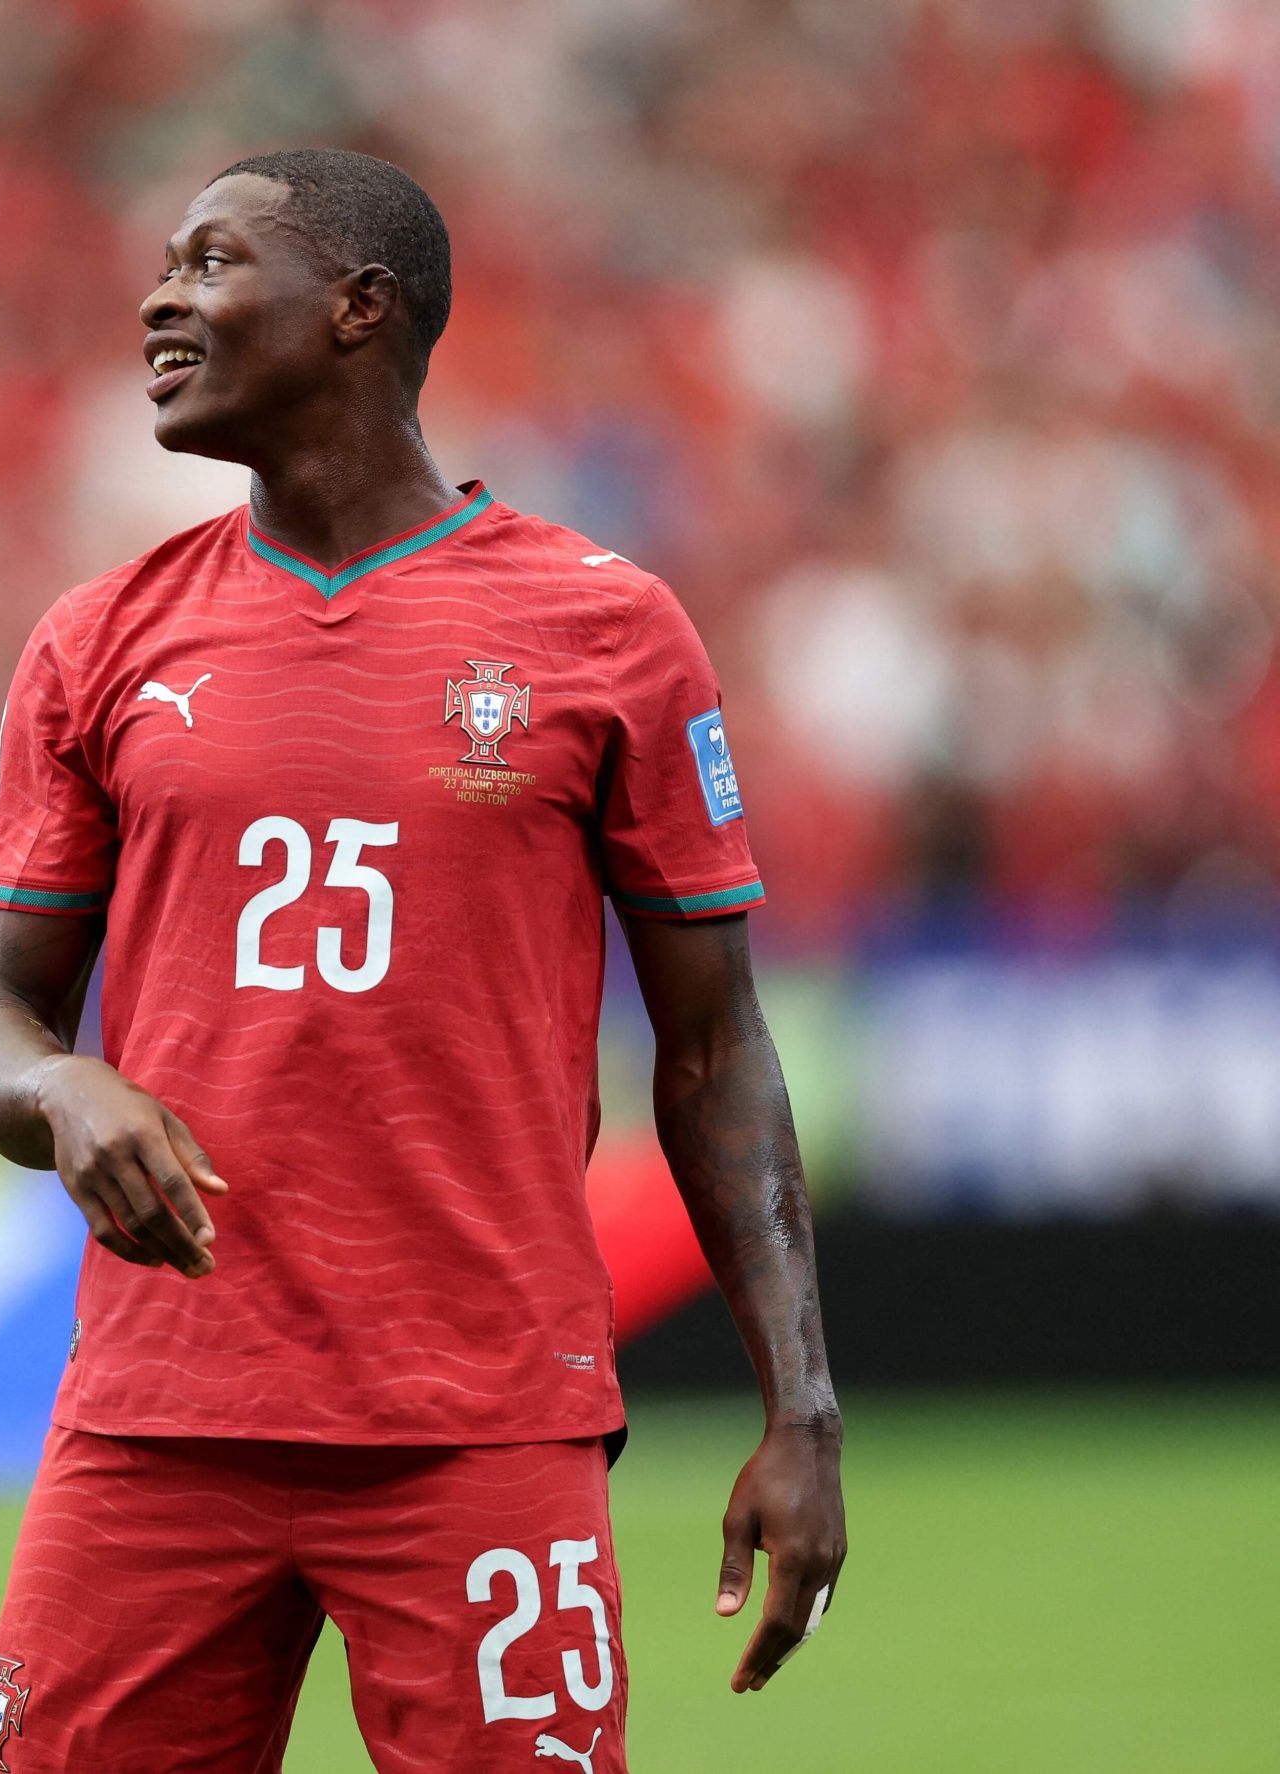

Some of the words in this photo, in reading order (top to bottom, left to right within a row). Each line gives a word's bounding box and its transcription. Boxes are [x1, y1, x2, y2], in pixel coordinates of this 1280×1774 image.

[443, 778, 457, 789] 23
[460, 779, 493, 792] JUNHO
[497, 782, 521, 795] 2026
[456, 790, 508, 805] HOUSTON
[235, 815, 399, 993] 25
[465, 1535, 614, 1724] 25
